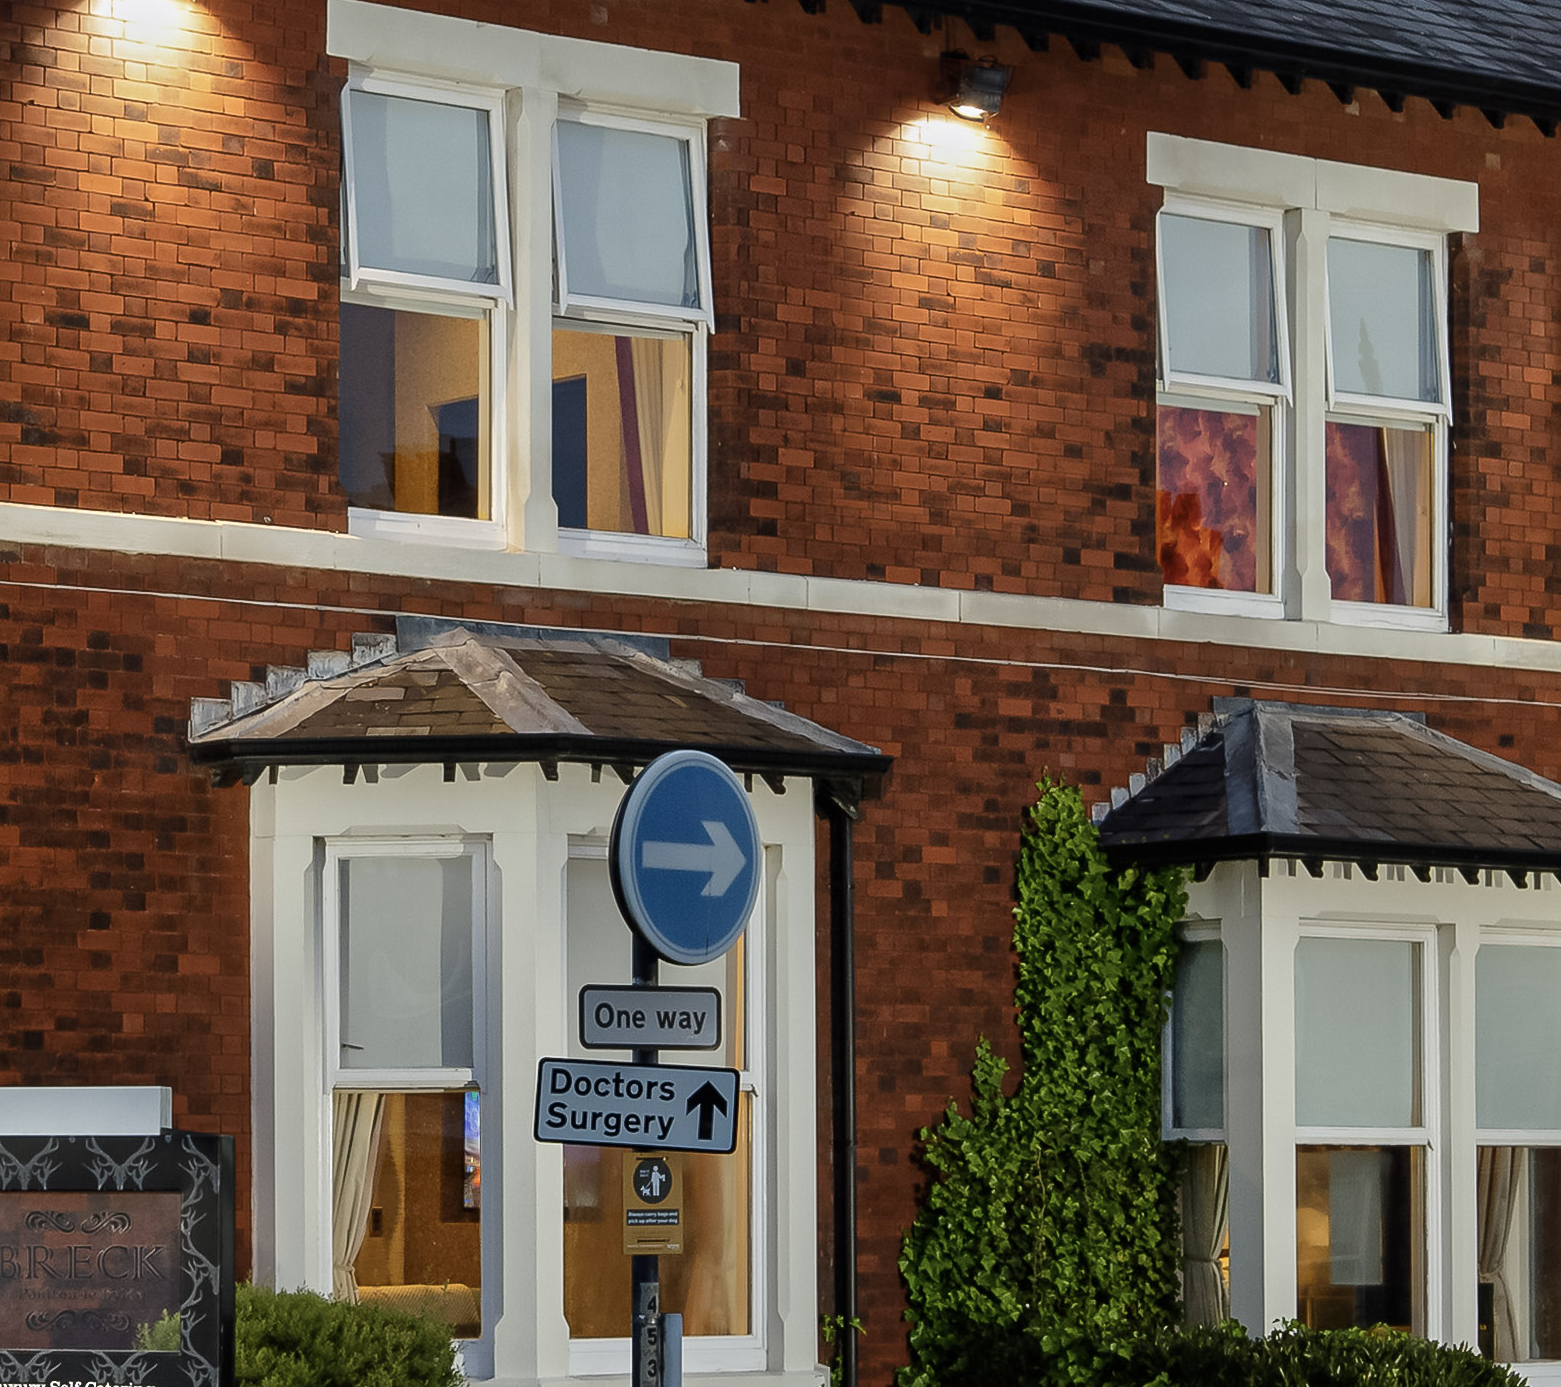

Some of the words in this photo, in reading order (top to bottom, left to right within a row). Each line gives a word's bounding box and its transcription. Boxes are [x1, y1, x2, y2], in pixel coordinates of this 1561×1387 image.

[594, 1002, 646, 1029] One
[656, 1010, 707, 1035] way
[550, 1068, 675, 1102] Doctors
[545, 1101, 675, 1141] Surgery
